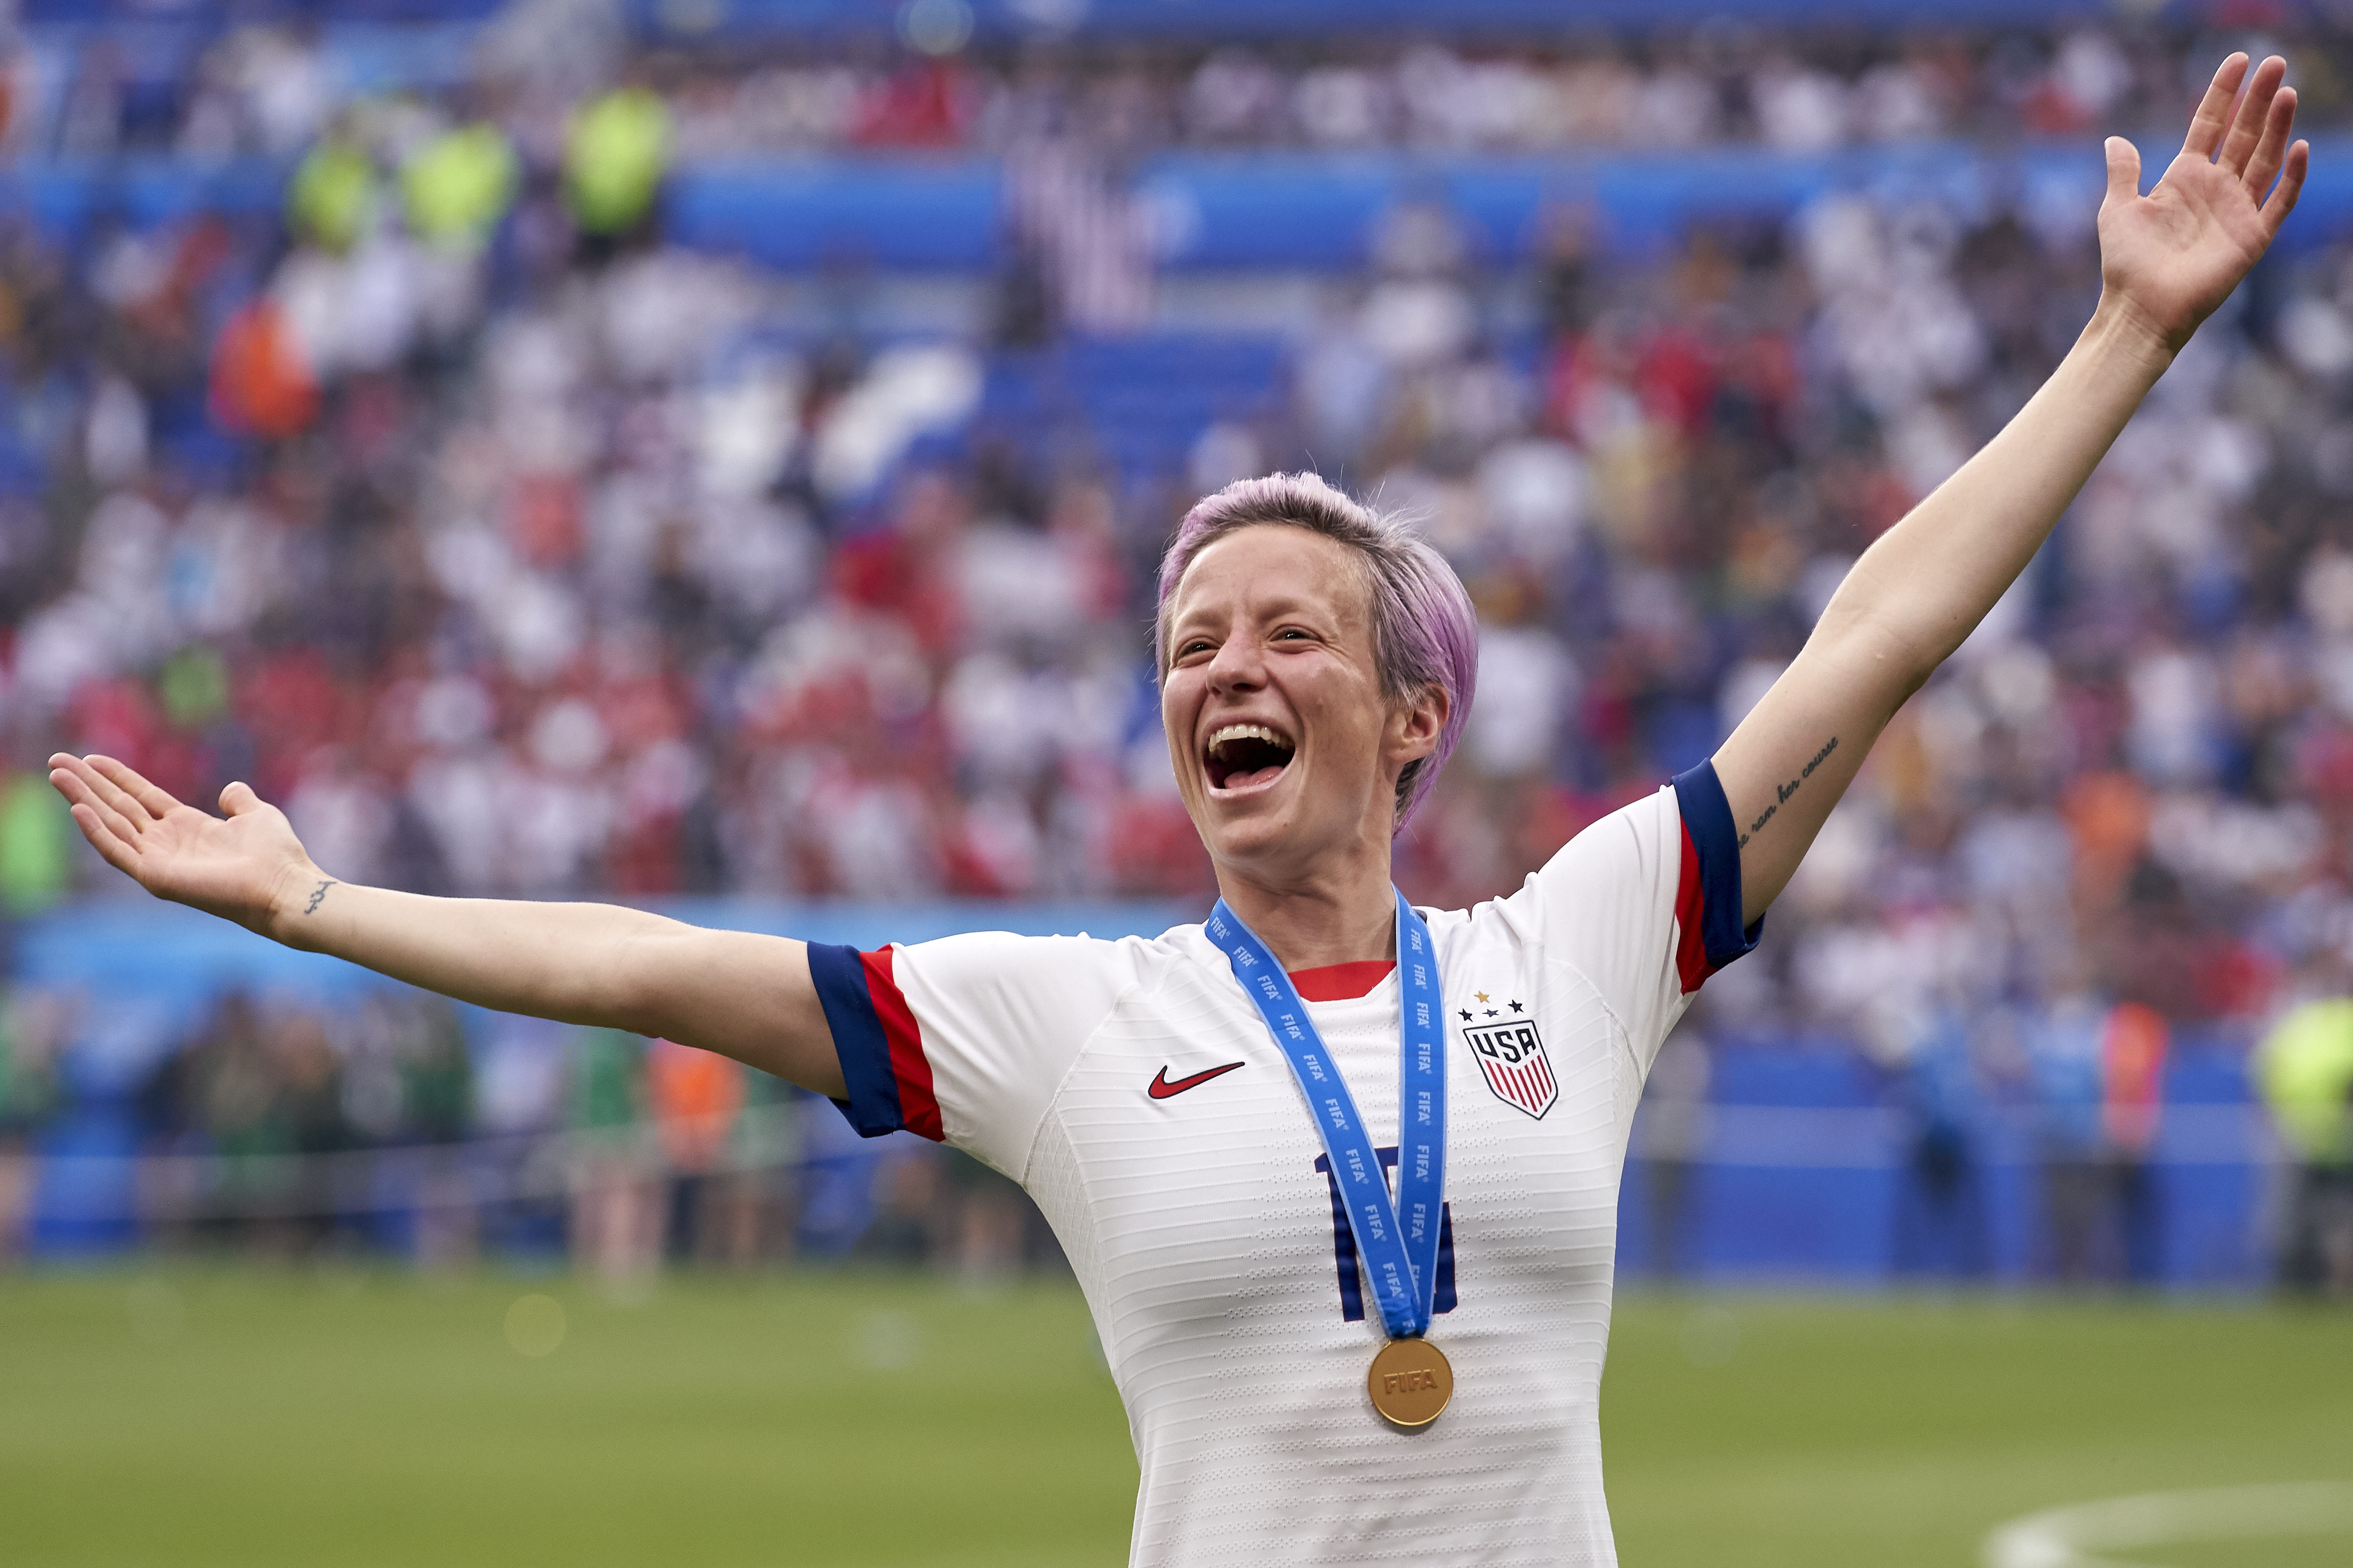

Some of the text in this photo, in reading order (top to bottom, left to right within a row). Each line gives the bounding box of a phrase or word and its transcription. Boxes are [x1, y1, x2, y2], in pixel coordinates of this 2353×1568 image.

[1751, 805, 1777, 832] ran
[1778, 779, 1800, 804] her
[1802, 737, 1839, 778] course
[1472, 1028, 1536, 1063] USA
[1383, 1369, 1437, 1394] FIFA
